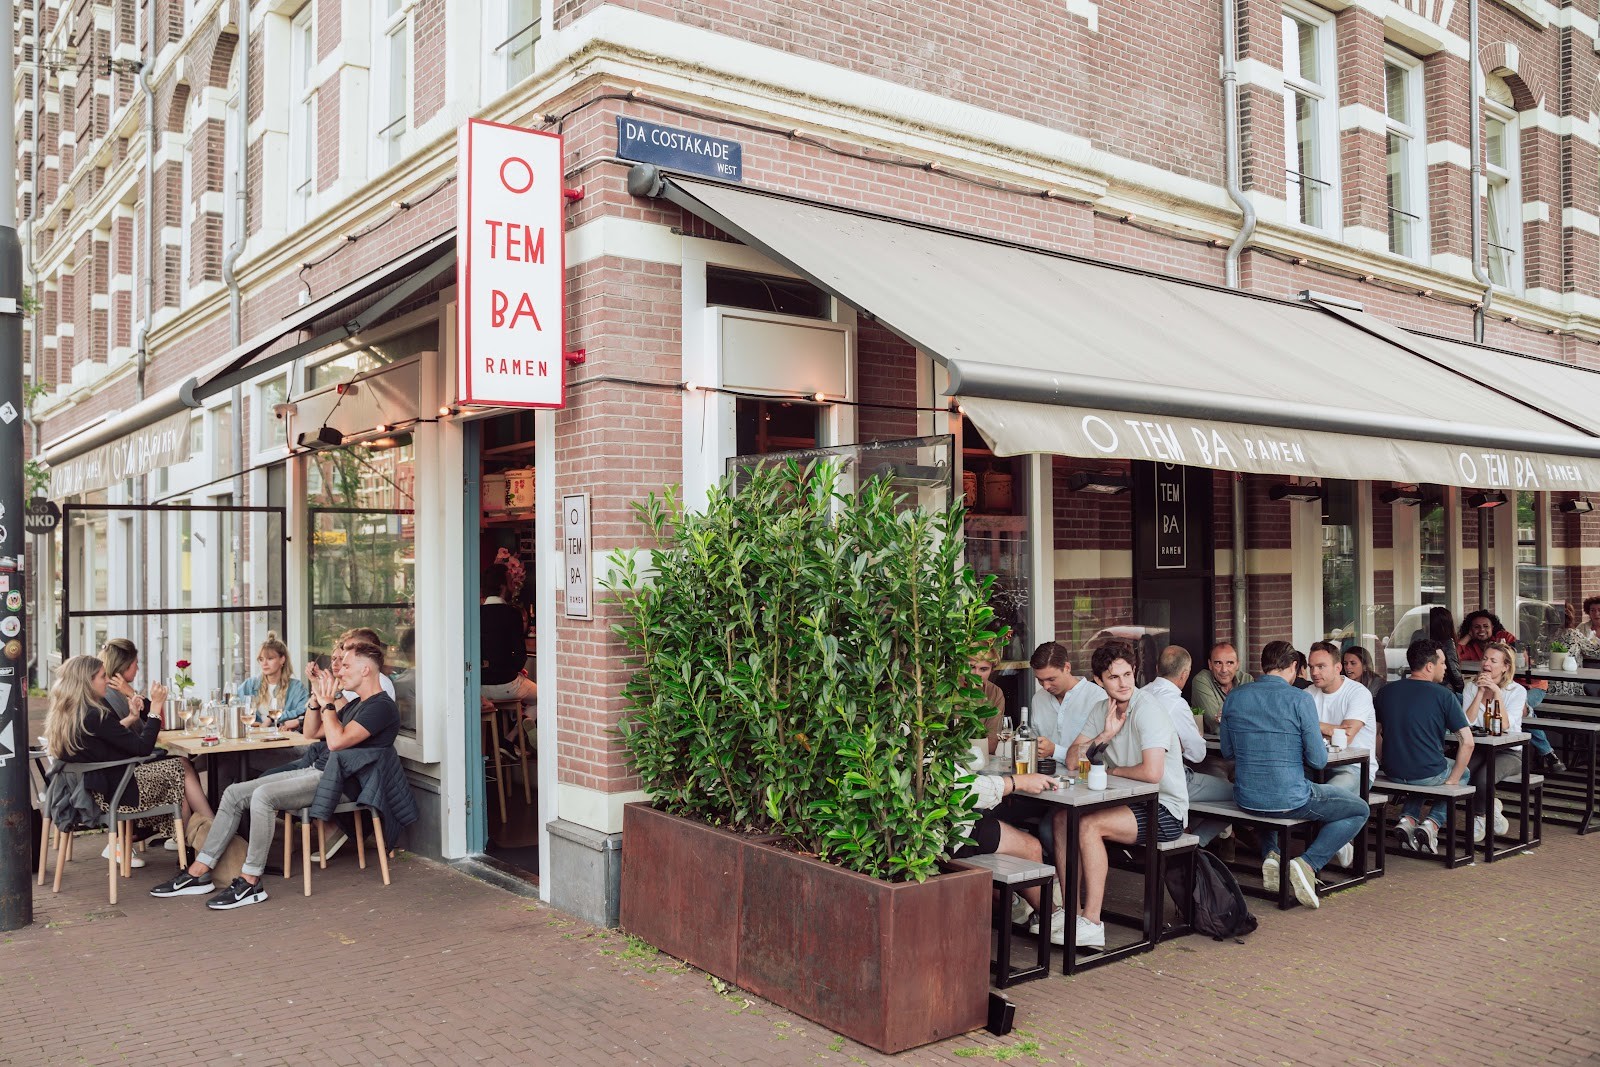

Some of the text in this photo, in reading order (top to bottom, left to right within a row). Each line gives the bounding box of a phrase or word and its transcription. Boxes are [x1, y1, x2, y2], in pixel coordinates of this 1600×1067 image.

[627, 122, 729, 160] DA COSTAKADE
[500, 157, 534, 194] O
[717, 162, 737, 175] WEST
[485, 219, 545, 265] TEM
[491, 289, 542, 332] BA
[486, 357, 547, 377] RAMEN
[1081, 415, 1306, 467] O TEM BA RAMEN
[1459, 452, 1583, 488] O TEM BA RAMEN
[1160, 483, 1180, 502] TEM
[31, 505, 49, 514] GO
[570, 508, 579, 525] O
[25, 514, 55, 527] NKD
[1163, 515, 1180, 533] BA
[568, 538, 582, 555] TEM
[1161, 546, 1182, 555] RAMEN
[570, 567, 582, 584] BA
[569, 596, 584, 604] RAMEN
